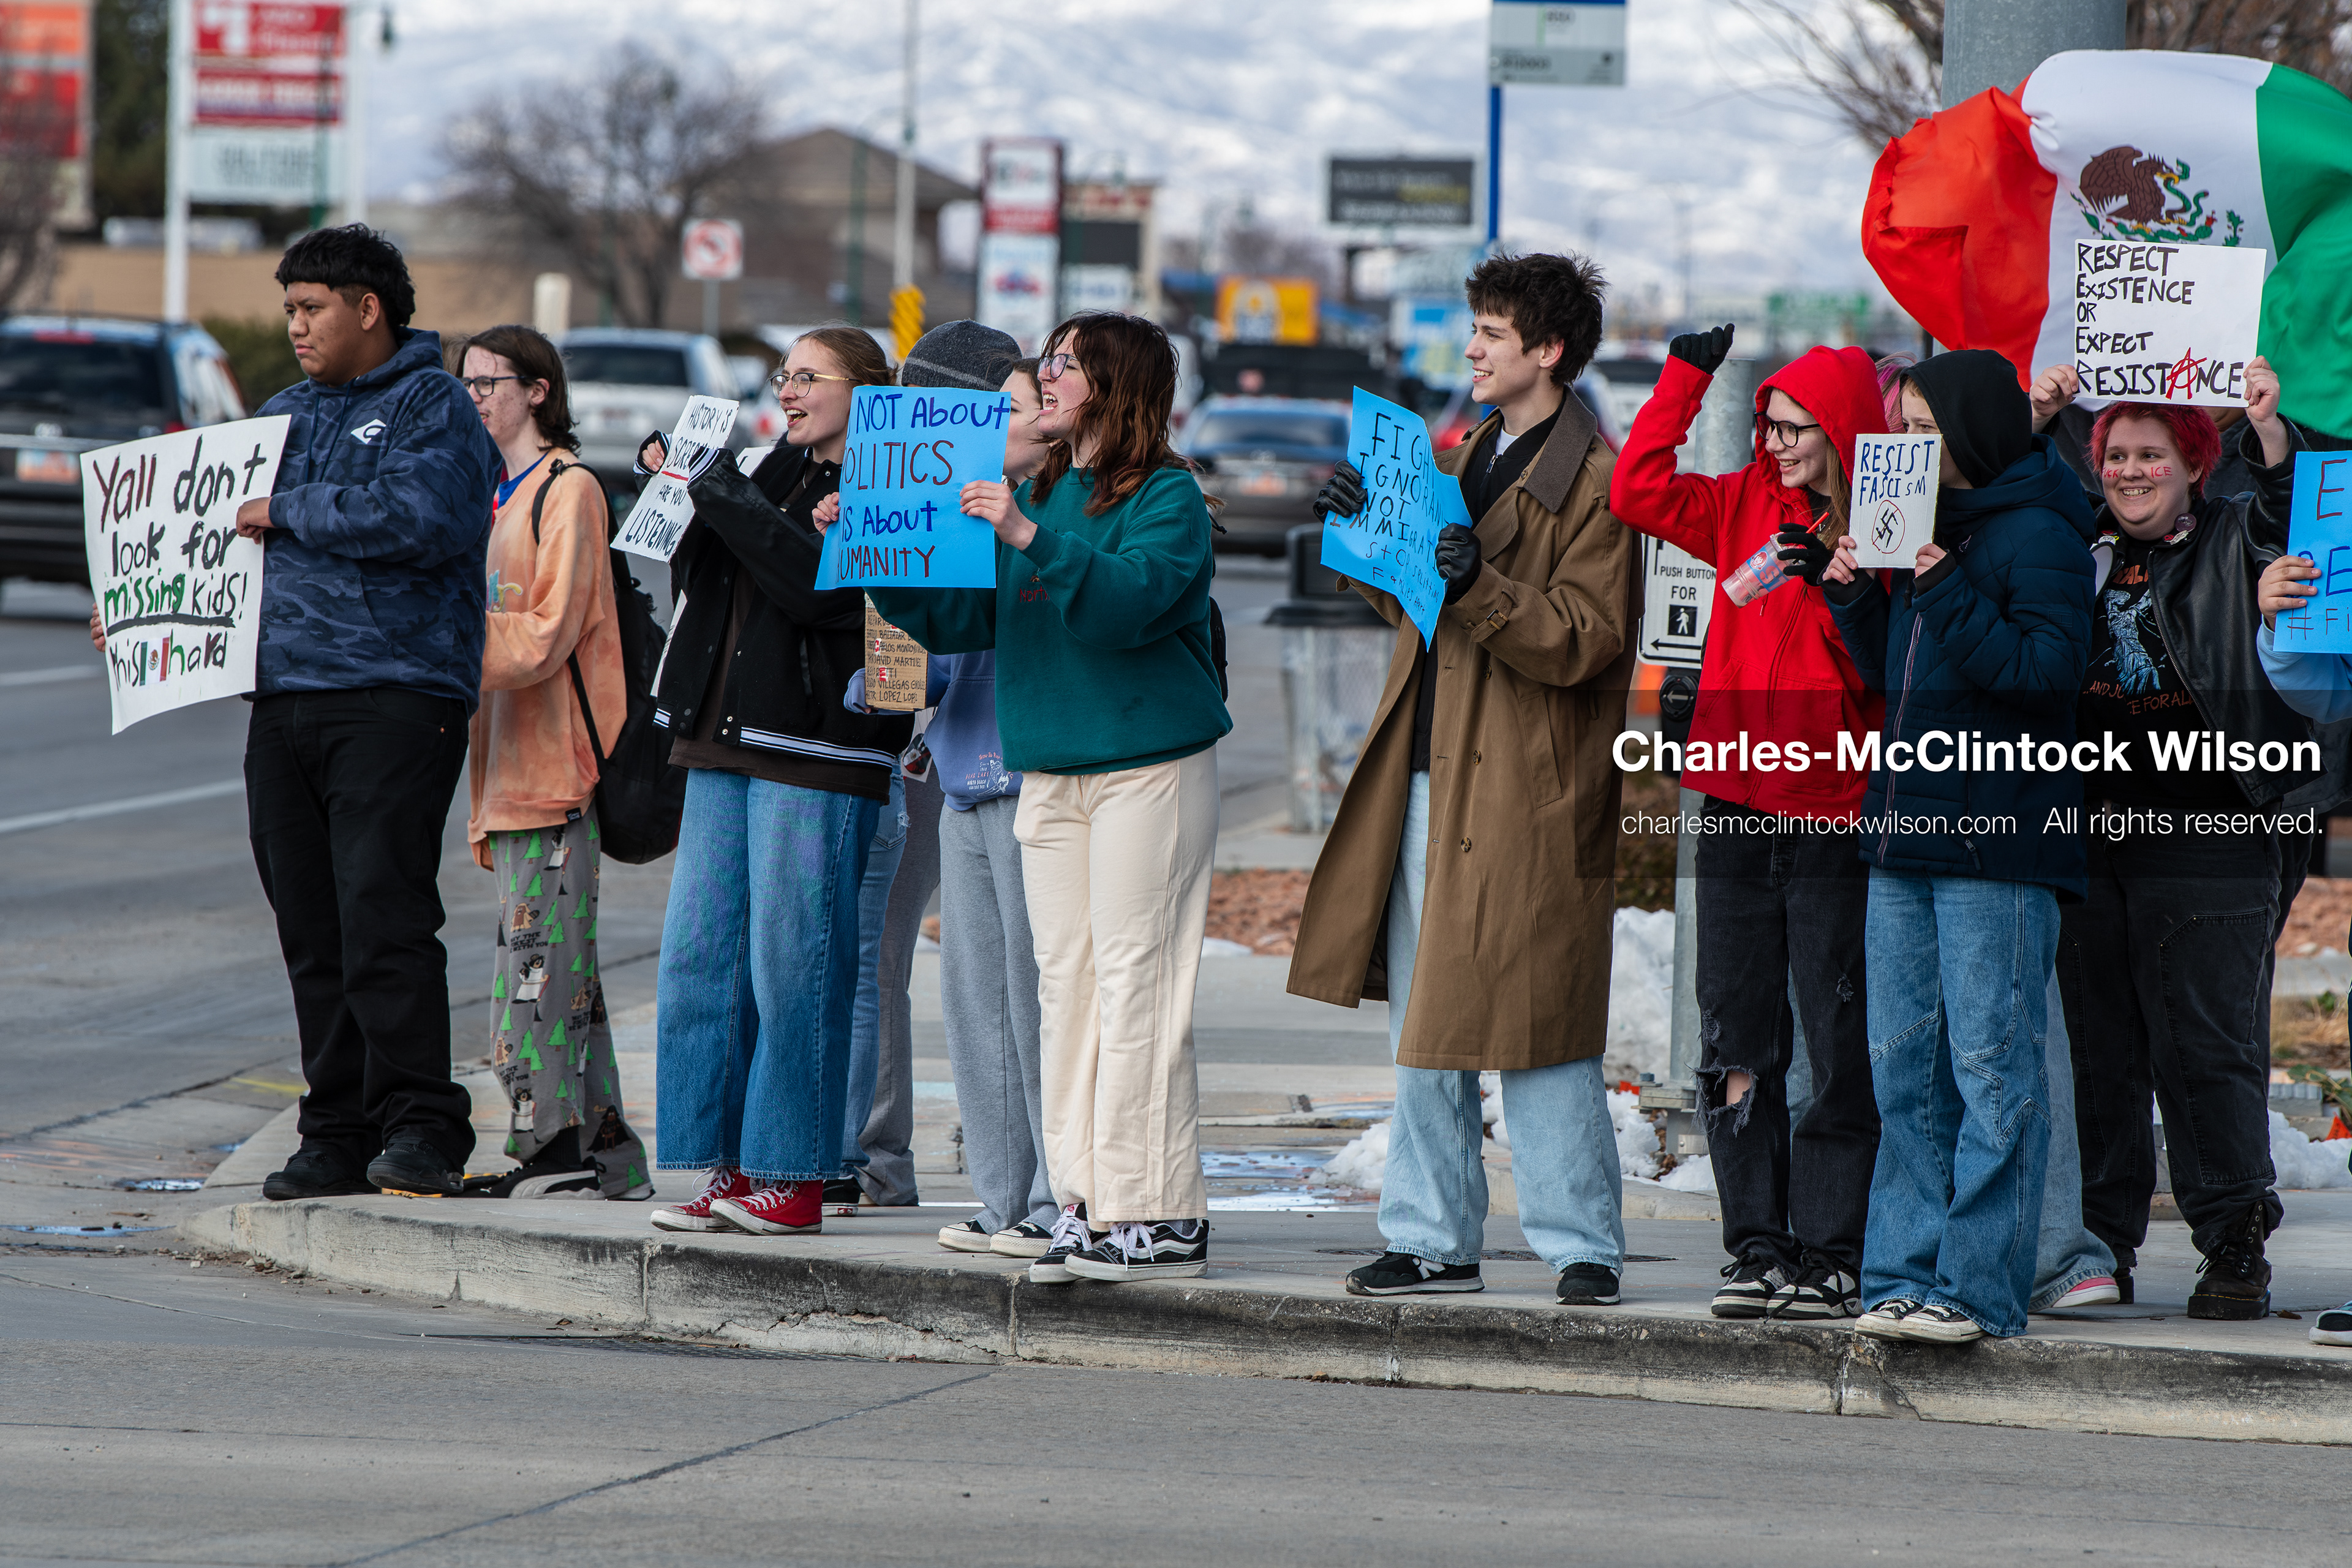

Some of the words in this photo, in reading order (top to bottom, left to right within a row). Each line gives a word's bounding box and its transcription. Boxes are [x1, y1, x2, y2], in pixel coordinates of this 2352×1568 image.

[2077, 243, 2179, 276] RESPECT
[2076, 301, 2097, 322] OR
[2076, 326, 2154, 355] EXPECT
[2076, 347, 2244, 400] RESISTANCE
[688, 403, 723, 440] HISTORY
[856, 394, 902, 434] NOT
[1860, 440, 1935, 476] RESIST
[2150, 467, 2173, 478] ICE
[655, 484, 672, 502] ARE
[670, 487, 687, 506] YOU
[1366, 491, 1411, 520] NOT
[112, 521, 165, 576] look
[181, 521, 238, 570] for
[1330, 512, 1437, 572] IMMIGRATI
[1660, 566, 1682, 578] PUSH
[1686, 568, 1716, 581] BUTTON
[104, 568, 185, 627] missing
[1671, 586, 1697, 600] FOR
[168, 628, 227, 676] hard
[878, 679, 910, 690] VILLEGAS
[880, 691, 902, 703] LOPEZ
[2143, 693, 2170, 712] FOR
